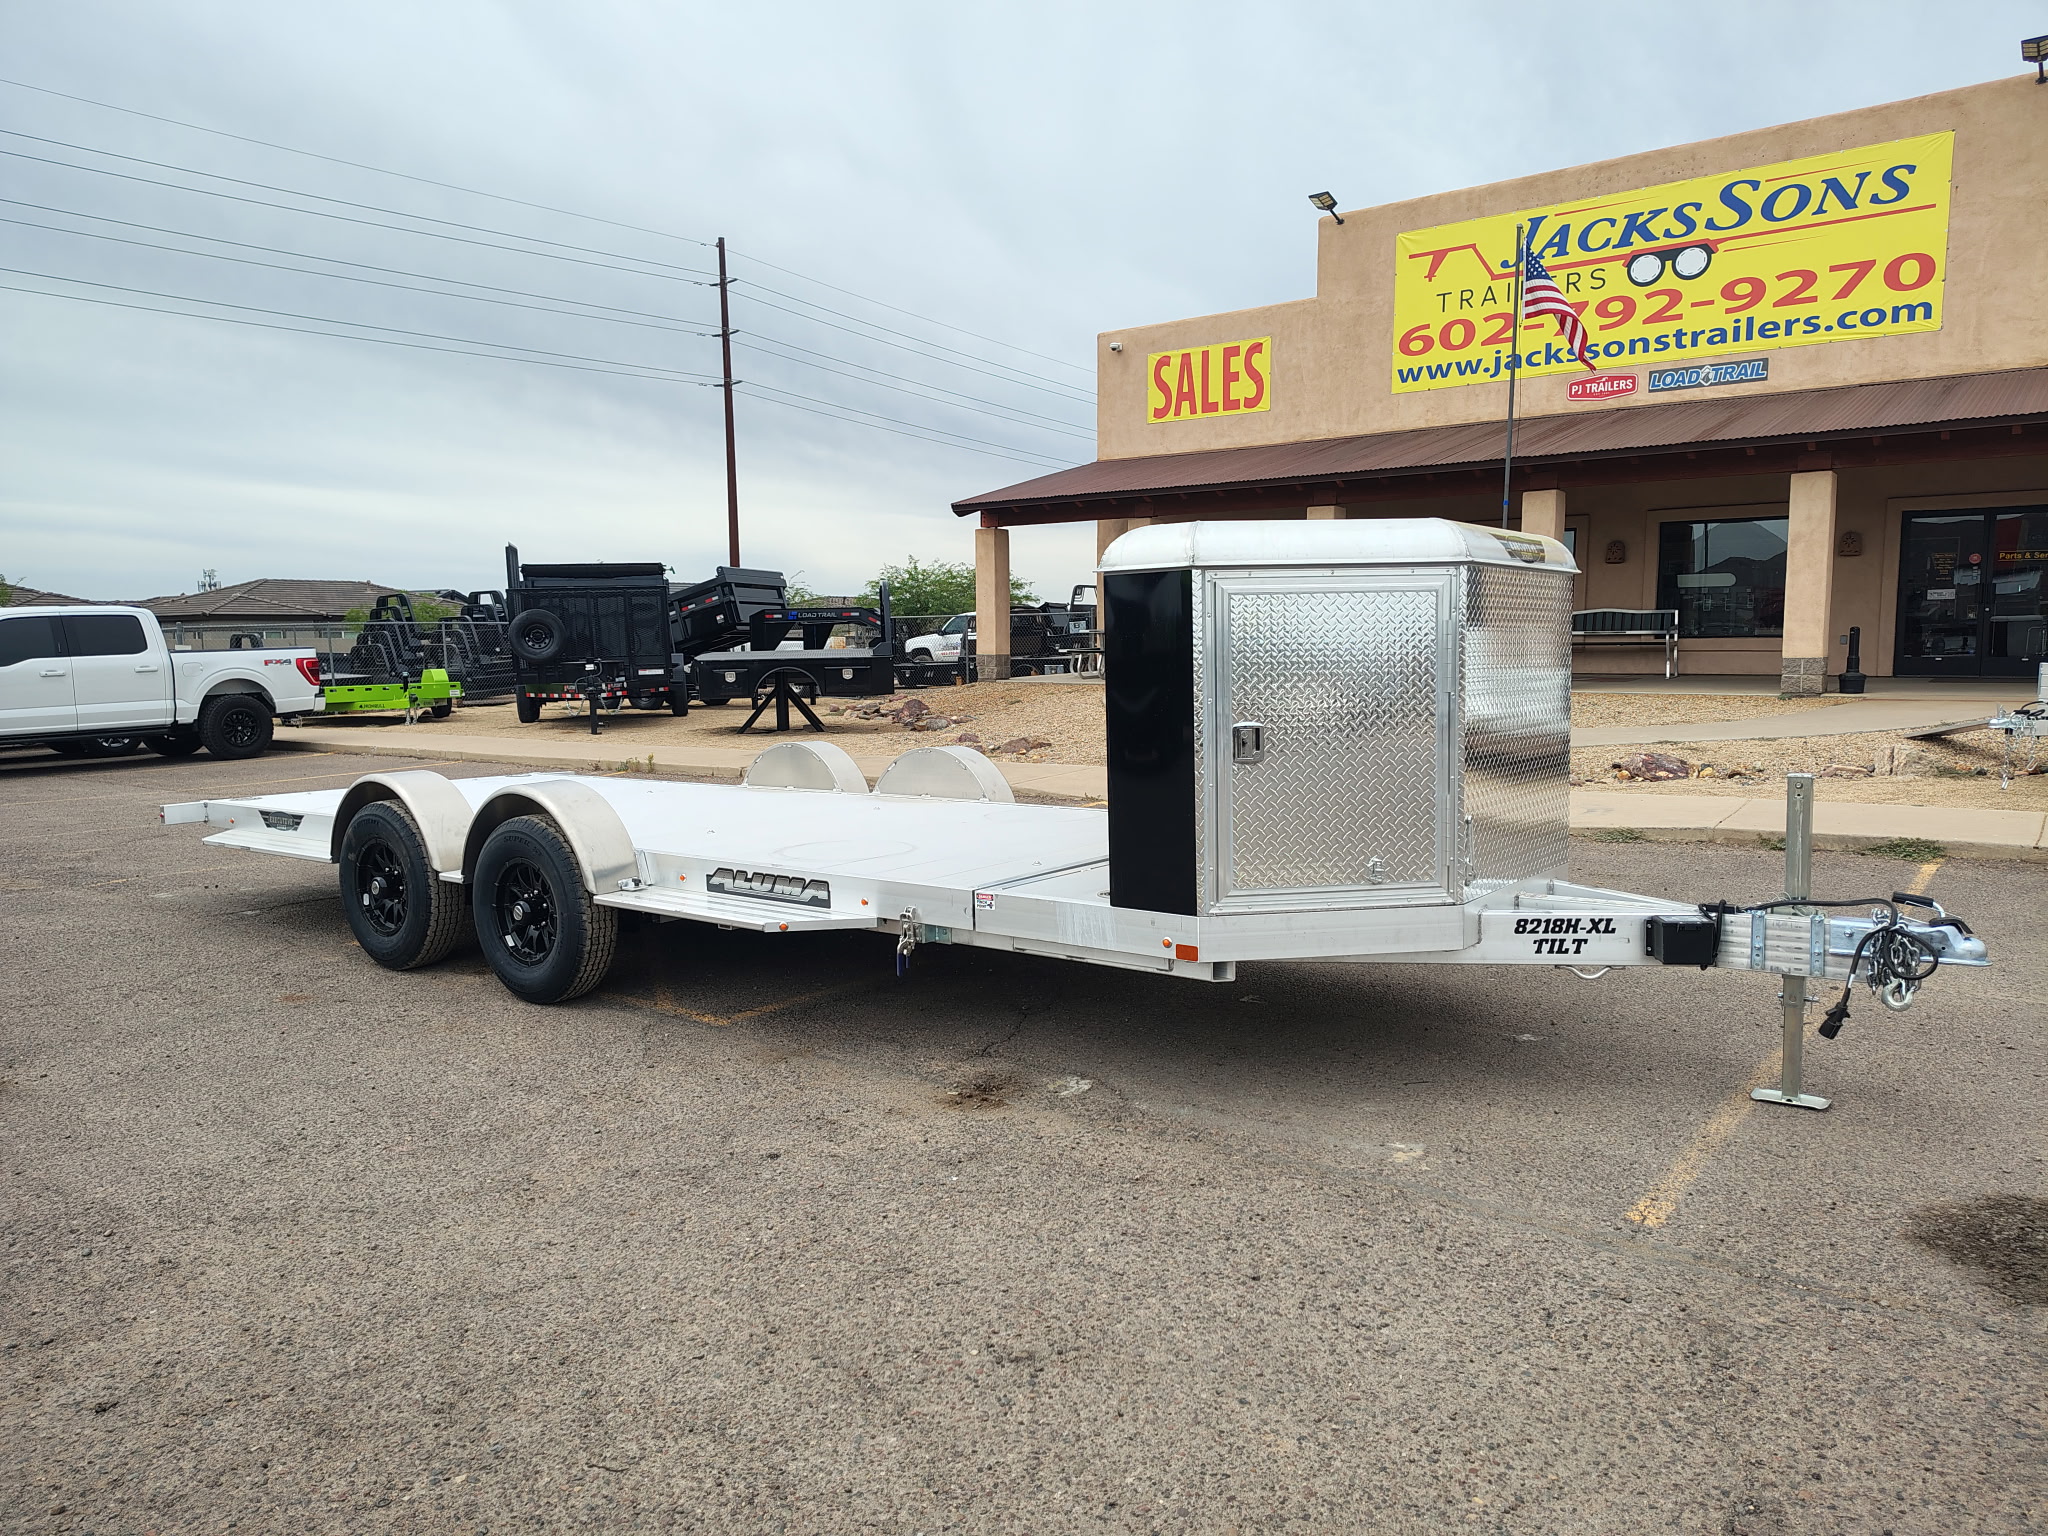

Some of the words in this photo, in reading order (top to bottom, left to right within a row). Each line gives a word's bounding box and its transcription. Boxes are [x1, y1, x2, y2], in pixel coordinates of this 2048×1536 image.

[1436, 268, 1607, 313] TRAIRS
[1397, 301, 1933, 384] www.jackssonstrailers.com
[1153, 342, 1265, 419] SALES
[1571, 384, 1583, 395] PJ
[1585, 379, 1633, 394] TRAILERS
[1650, 370, 1701, 389] LOAD
[1711, 361, 1767, 382] TRAIL
[1999, 552, 2022, 560] Parts
[2024, 551, 2032, 559] &
[708, 868, 830, 903] ALUMA
[1514, 918, 1617, 935] 8218H-XL
[1532, 938, 1589, 955] TILT
